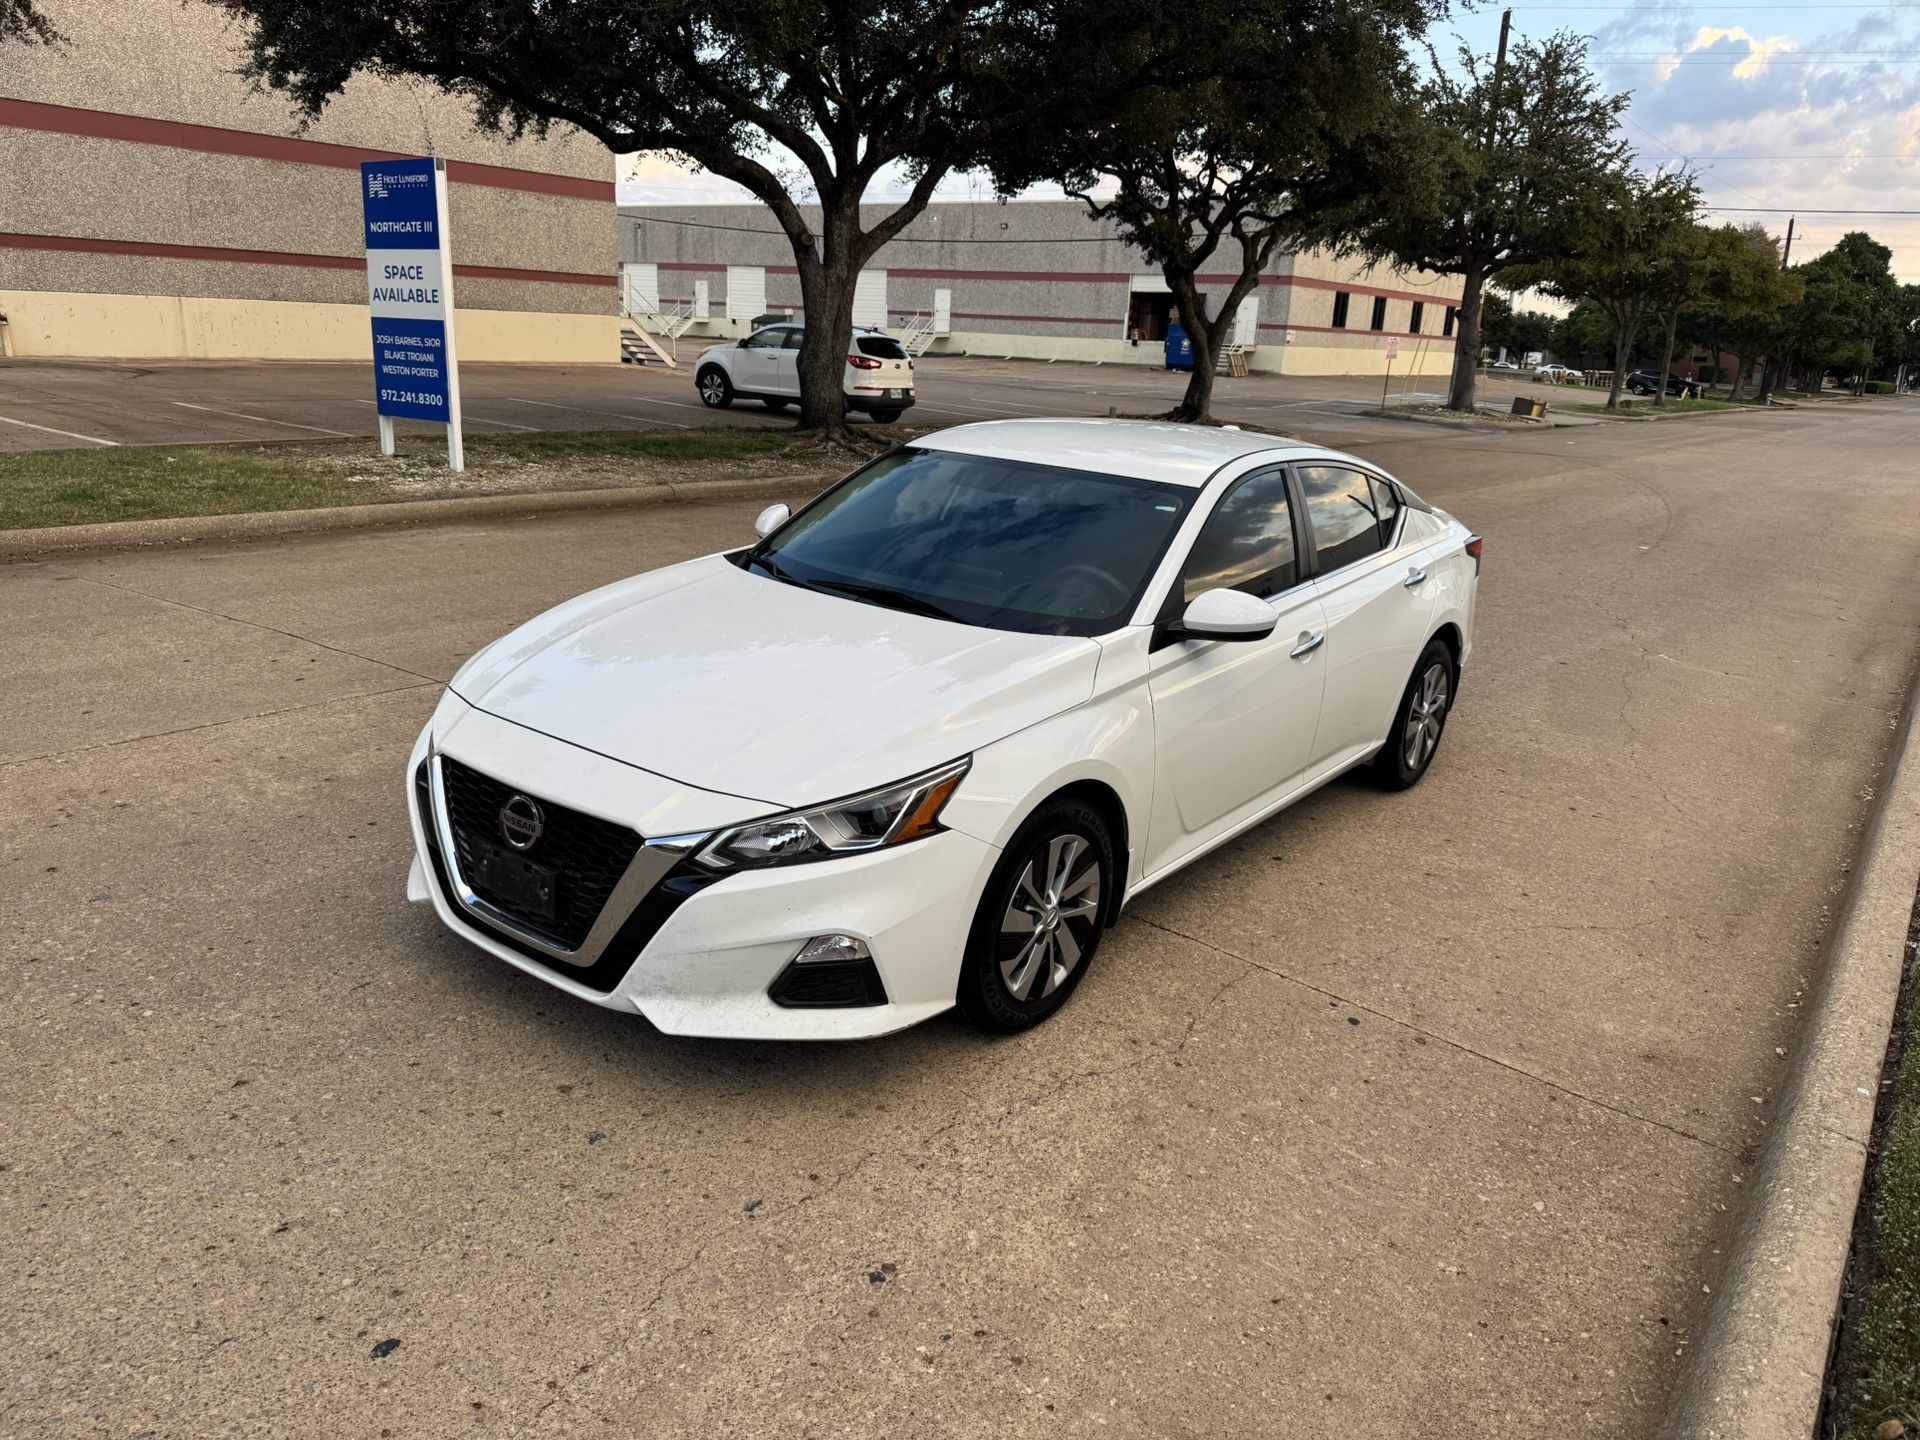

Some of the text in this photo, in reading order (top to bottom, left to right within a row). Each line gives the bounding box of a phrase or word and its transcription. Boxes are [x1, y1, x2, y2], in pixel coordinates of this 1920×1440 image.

[383, 174, 428, 184] HOLT LUNSFORD
[370, 221, 433, 233] NORTHGATE III
[384, 265, 424, 280] SPACE
[372, 287, 439, 304] AVAILABLE
[376, 334, 441, 348] JOSH BARNES, SIOR
[384, 350, 434, 362] BLAKE TROIANI
[382, 365, 439, 378] WESTON PORTER
[381, 389, 443, 406] 972.241.8300
[503, 812, 536, 833] NISSAN
